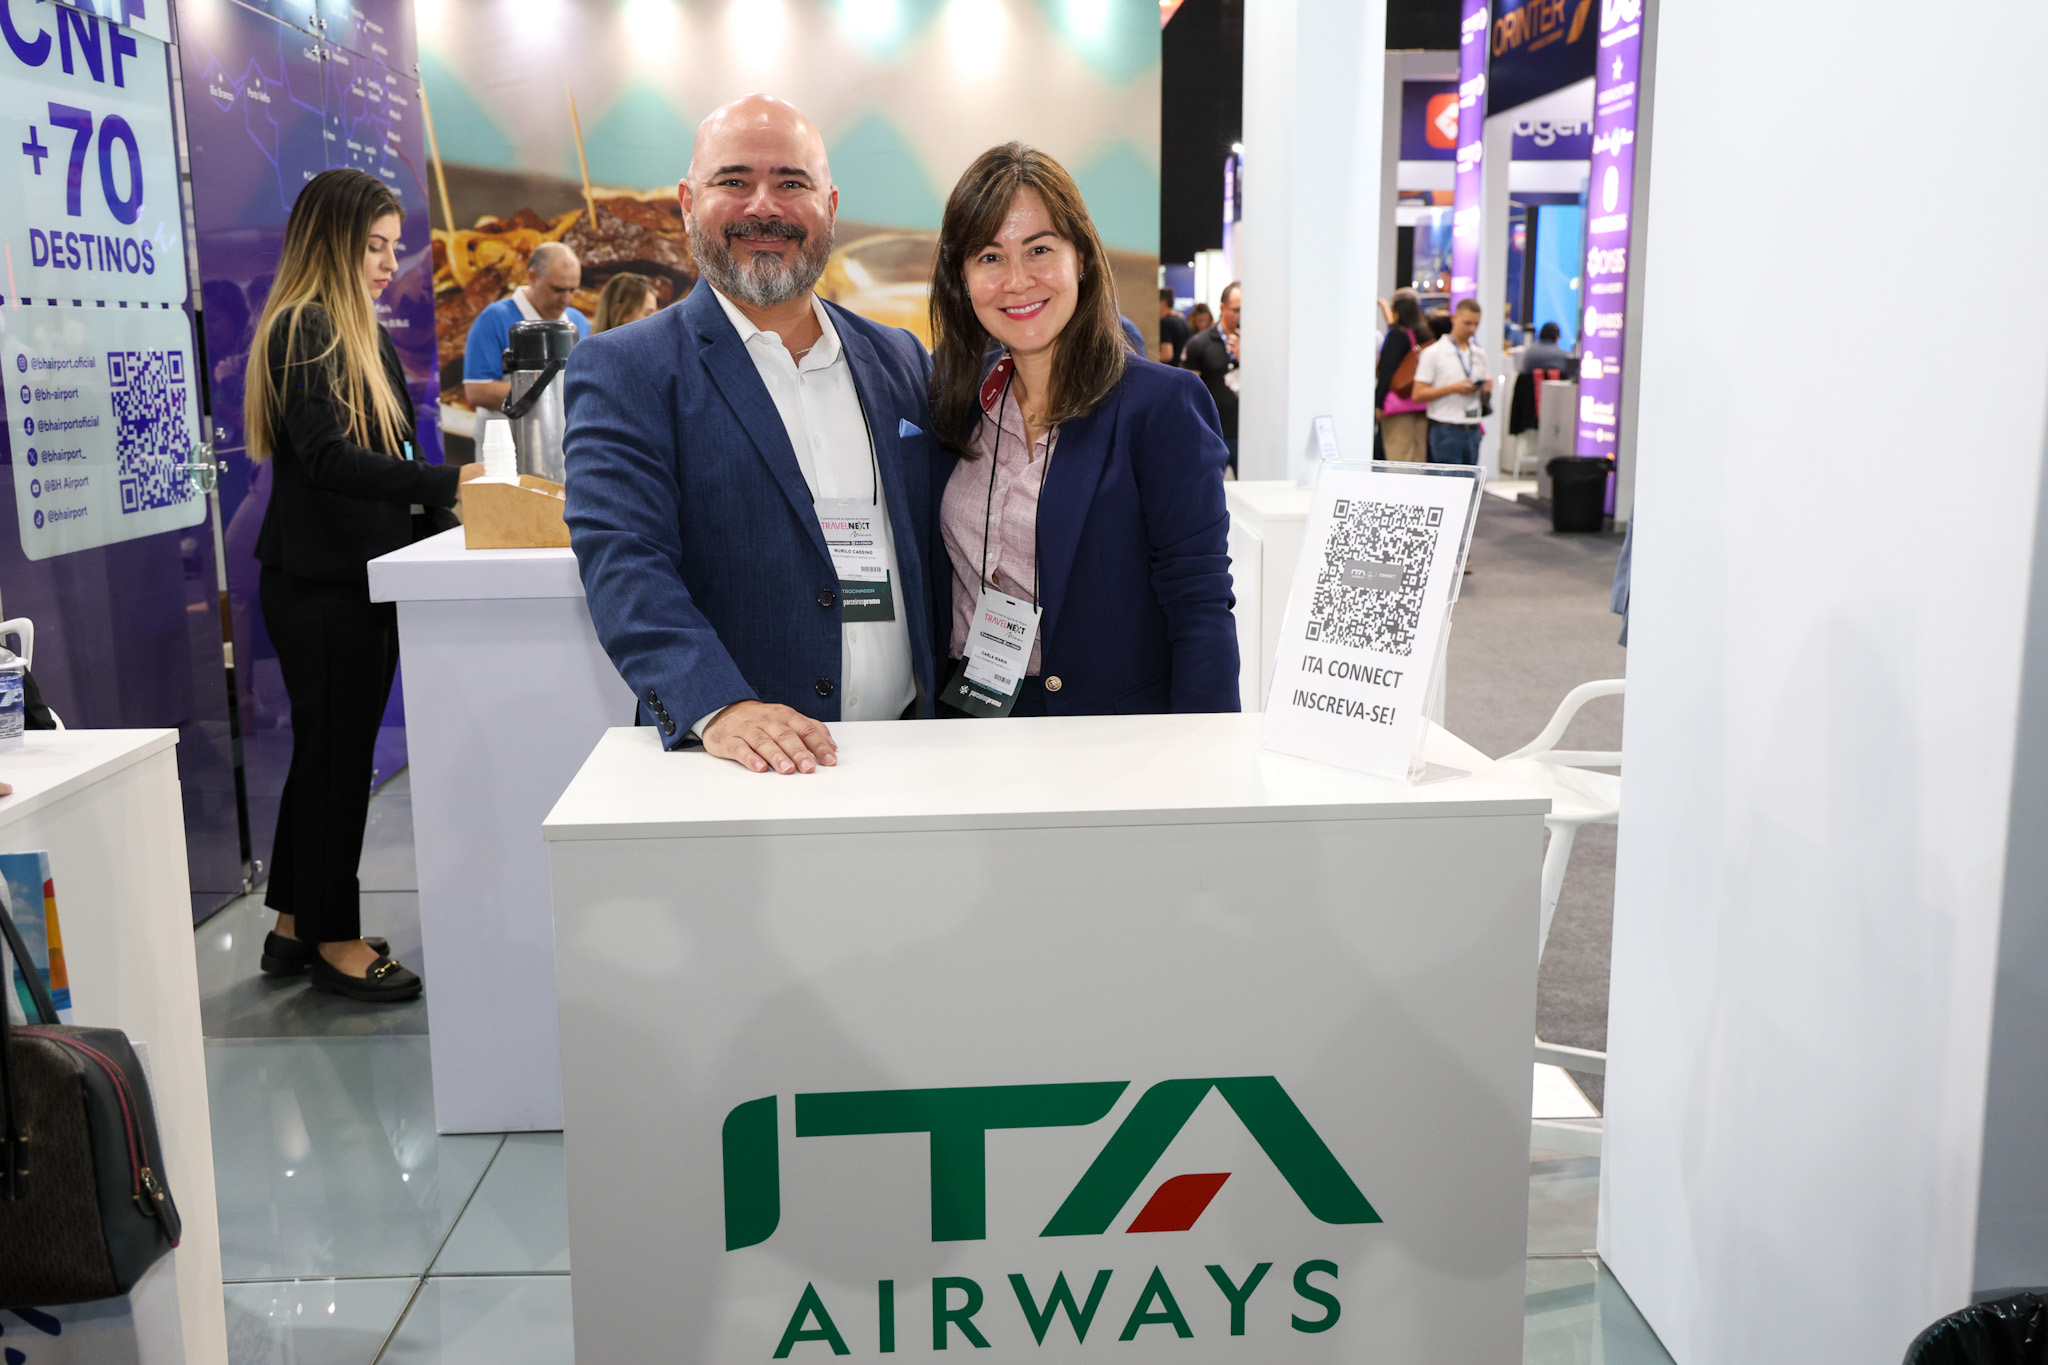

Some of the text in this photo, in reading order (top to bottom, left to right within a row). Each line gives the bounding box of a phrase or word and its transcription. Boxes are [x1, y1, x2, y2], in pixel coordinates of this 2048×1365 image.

[0, 0, 140, 88] CNF
[22, 101, 144, 225] +70
[29, 228, 155, 275] DESTINOS
[31, 356, 96, 371] @bhairport.oficial
[34, 387, 79, 402] @bh-airport
[38, 415, 100, 433] @bhairportoficial
[41, 448, 87, 463] @bhairport_
[44, 476, 89, 492] @BH Airport
[47, 506, 88, 522] @bhairport
[821, 521, 870, 531] TRAVELNEXT
[985, 613, 1026, 635] TRAVELNEXT
[1301, 655, 1404, 689] ITA CONNECT
[1292, 689, 1396, 726] INSCREVA-SE!
[722, 1075, 1384, 1252] ITA
[772, 1259, 1341, 1359] AIRWAYS
